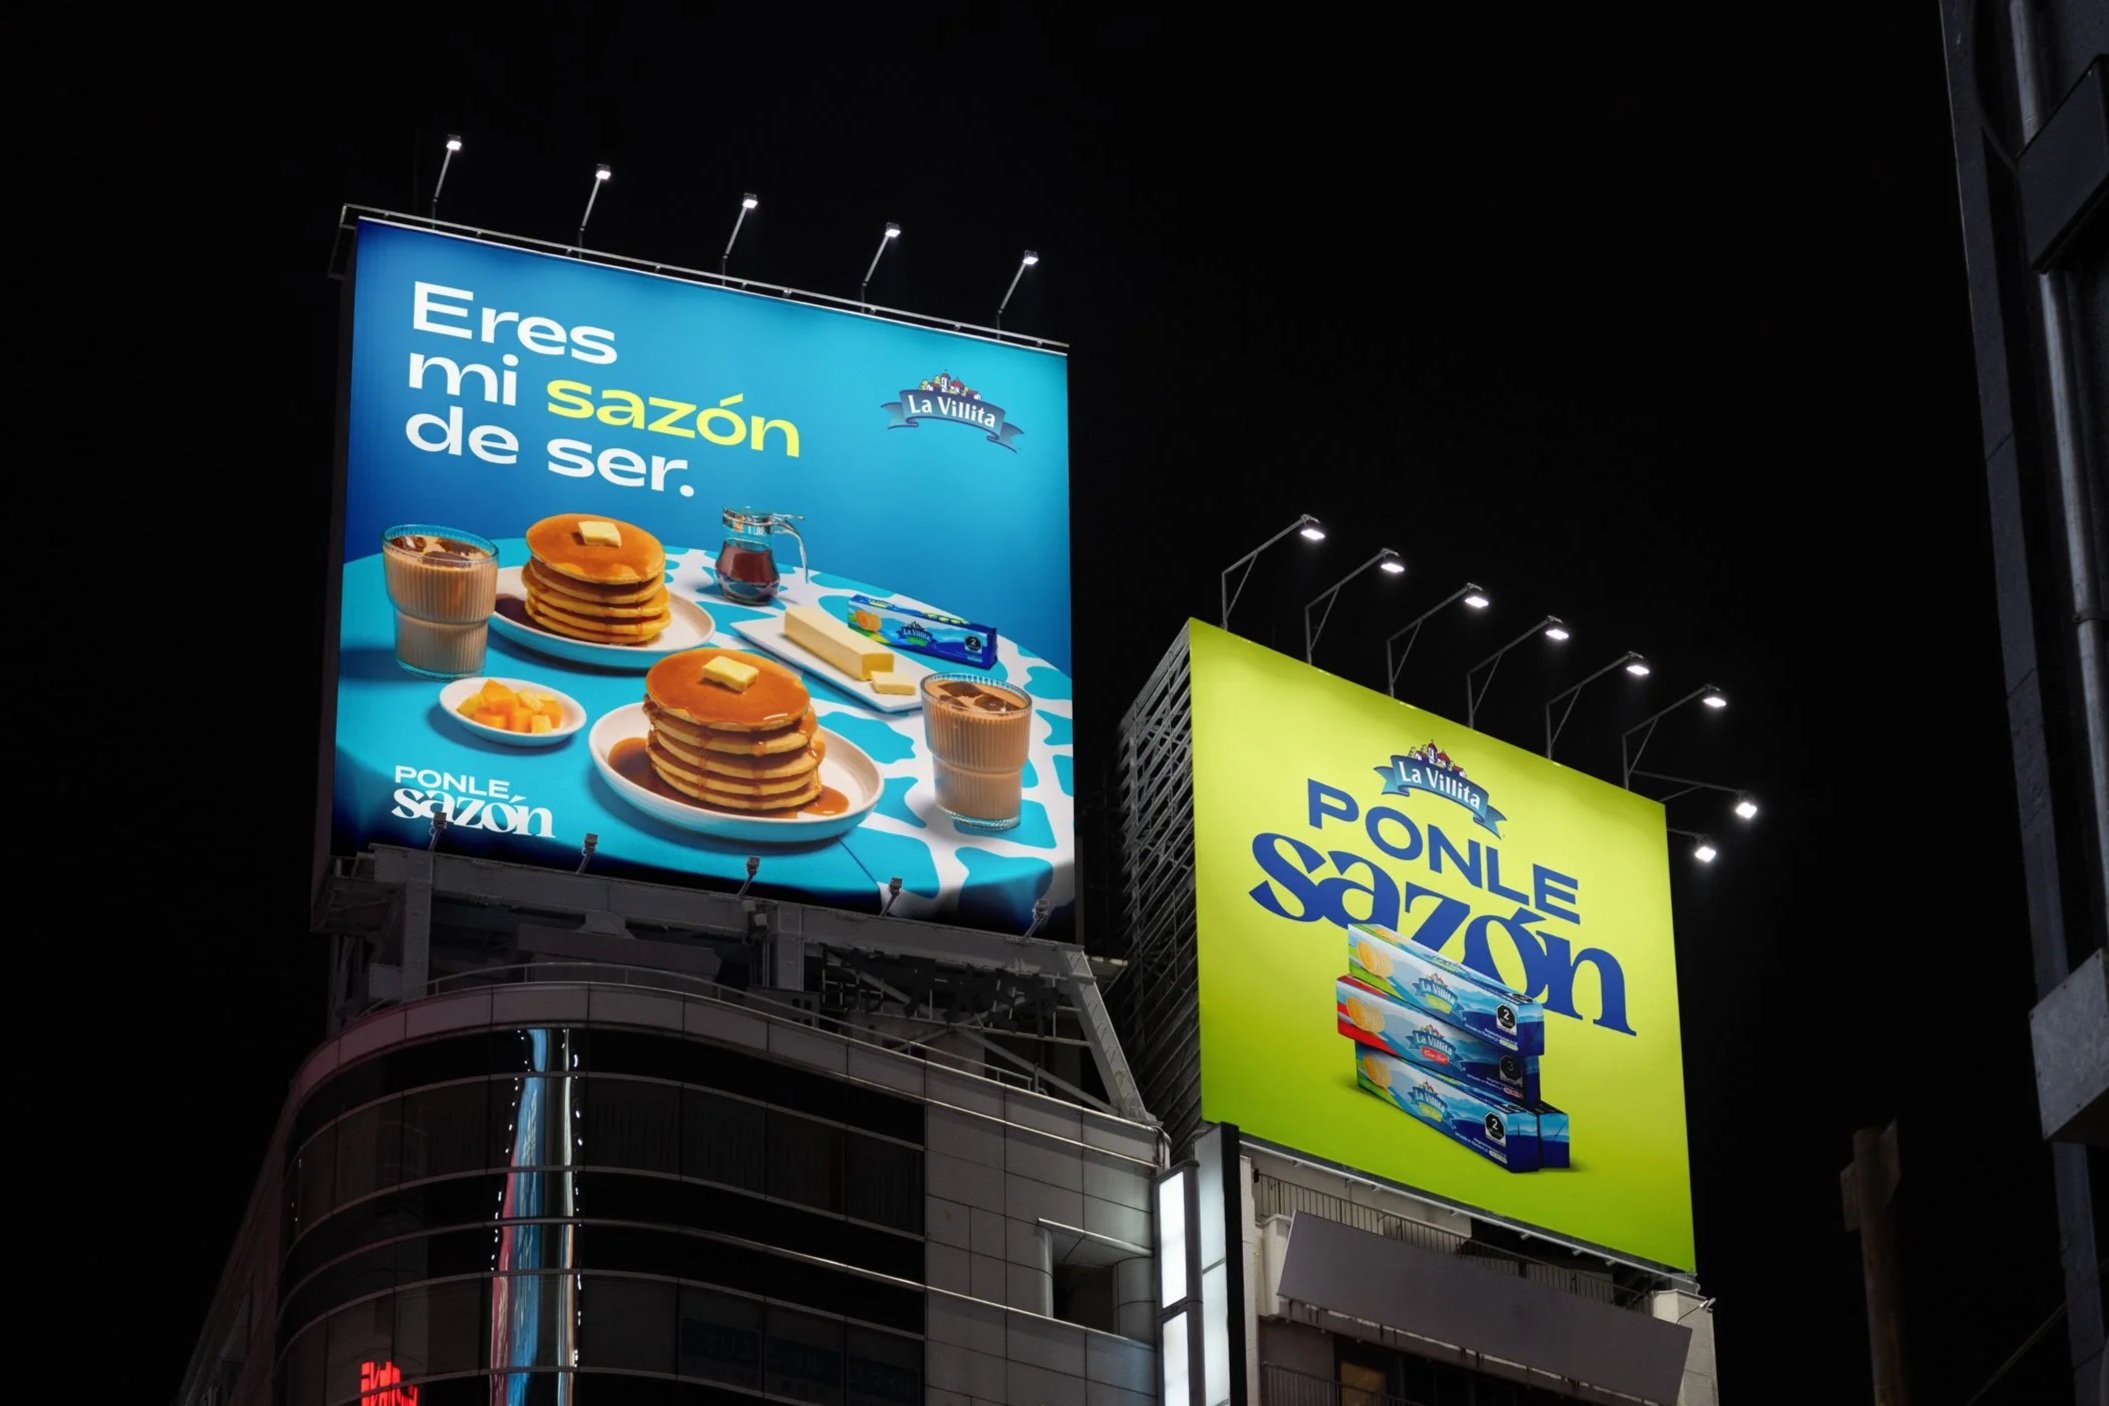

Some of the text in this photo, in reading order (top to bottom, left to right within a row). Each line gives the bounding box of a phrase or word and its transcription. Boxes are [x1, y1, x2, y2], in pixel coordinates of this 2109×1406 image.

[413, 281, 618, 365] Eres
[408, 352, 800, 458] mi sazón
[907, 395, 996, 428] La Villita
[405, 405, 695, 497] de ser.
[395, 765, 510, 799] PONLE
[1399, 761, 1481, 810] La Villita
[391, 788, 556, 839] sazón
[1307, 778, 1581, 925] PONLE
[1248, 832, 1637, 1036] sazón
[1421, 980, 1432, 991] La
[1432, 983, 1455, 1004] Villita
[1503, 1009, 1510, 1020] 2
[1415, 1033, 1453, 1056] La Villita
[1491, 1118, 1498, 1130] 2
